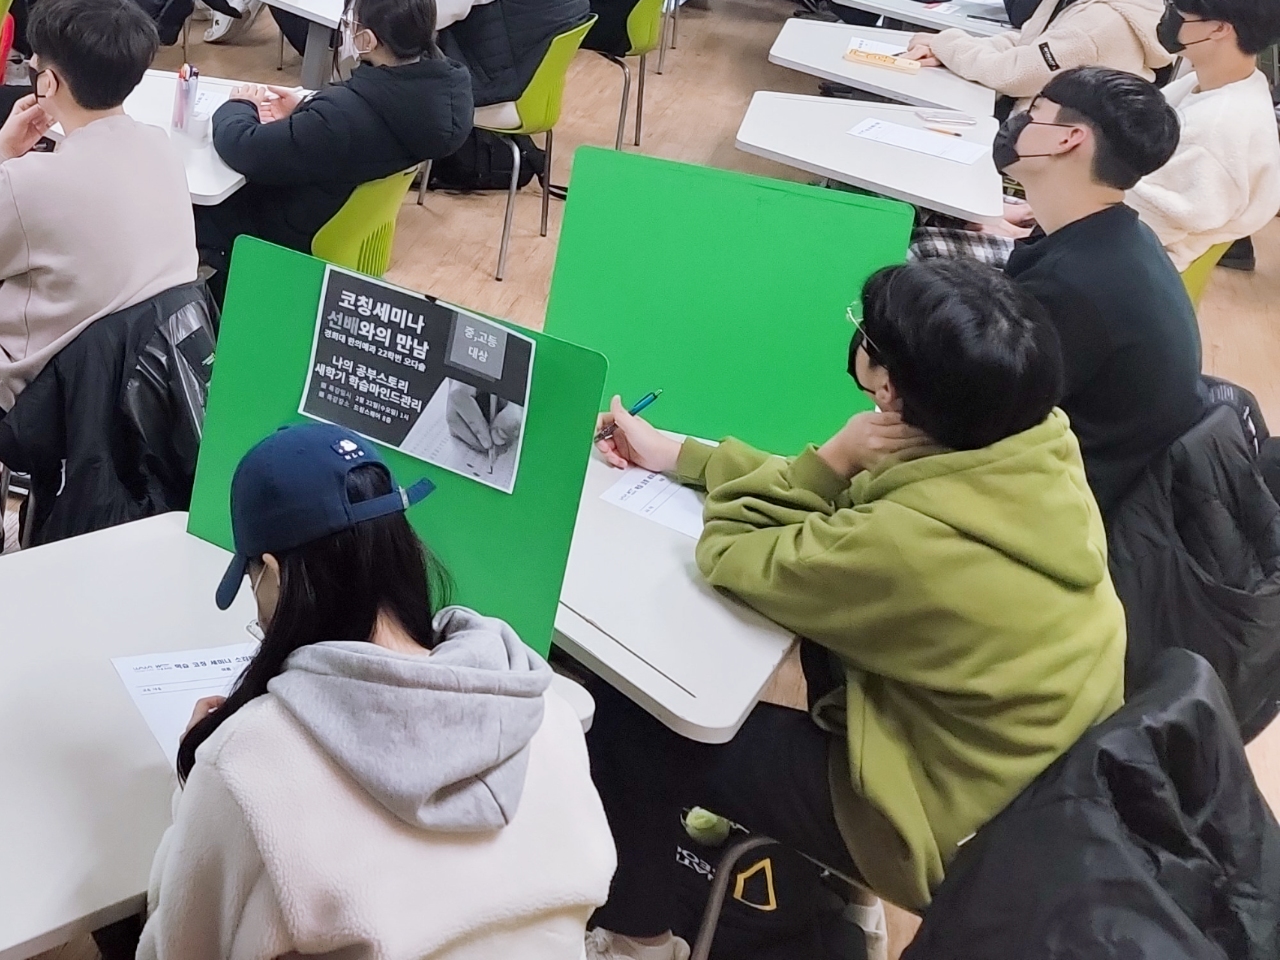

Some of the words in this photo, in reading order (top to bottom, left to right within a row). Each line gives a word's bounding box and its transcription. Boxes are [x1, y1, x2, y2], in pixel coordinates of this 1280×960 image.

[338, 290, 425, 335] 코칭세미나
[327, 311, 392, 347] 선배와의
[396, 333, 429, 360] 만남
[468, 346, 489, 363] 대상
[314, 363, 346, 385] 새학기
[348, 374, 422, 413] 학습마인드관리
[332, 355, 354, 373] 나의
[356, 363, 409, 394] 공부스토리
